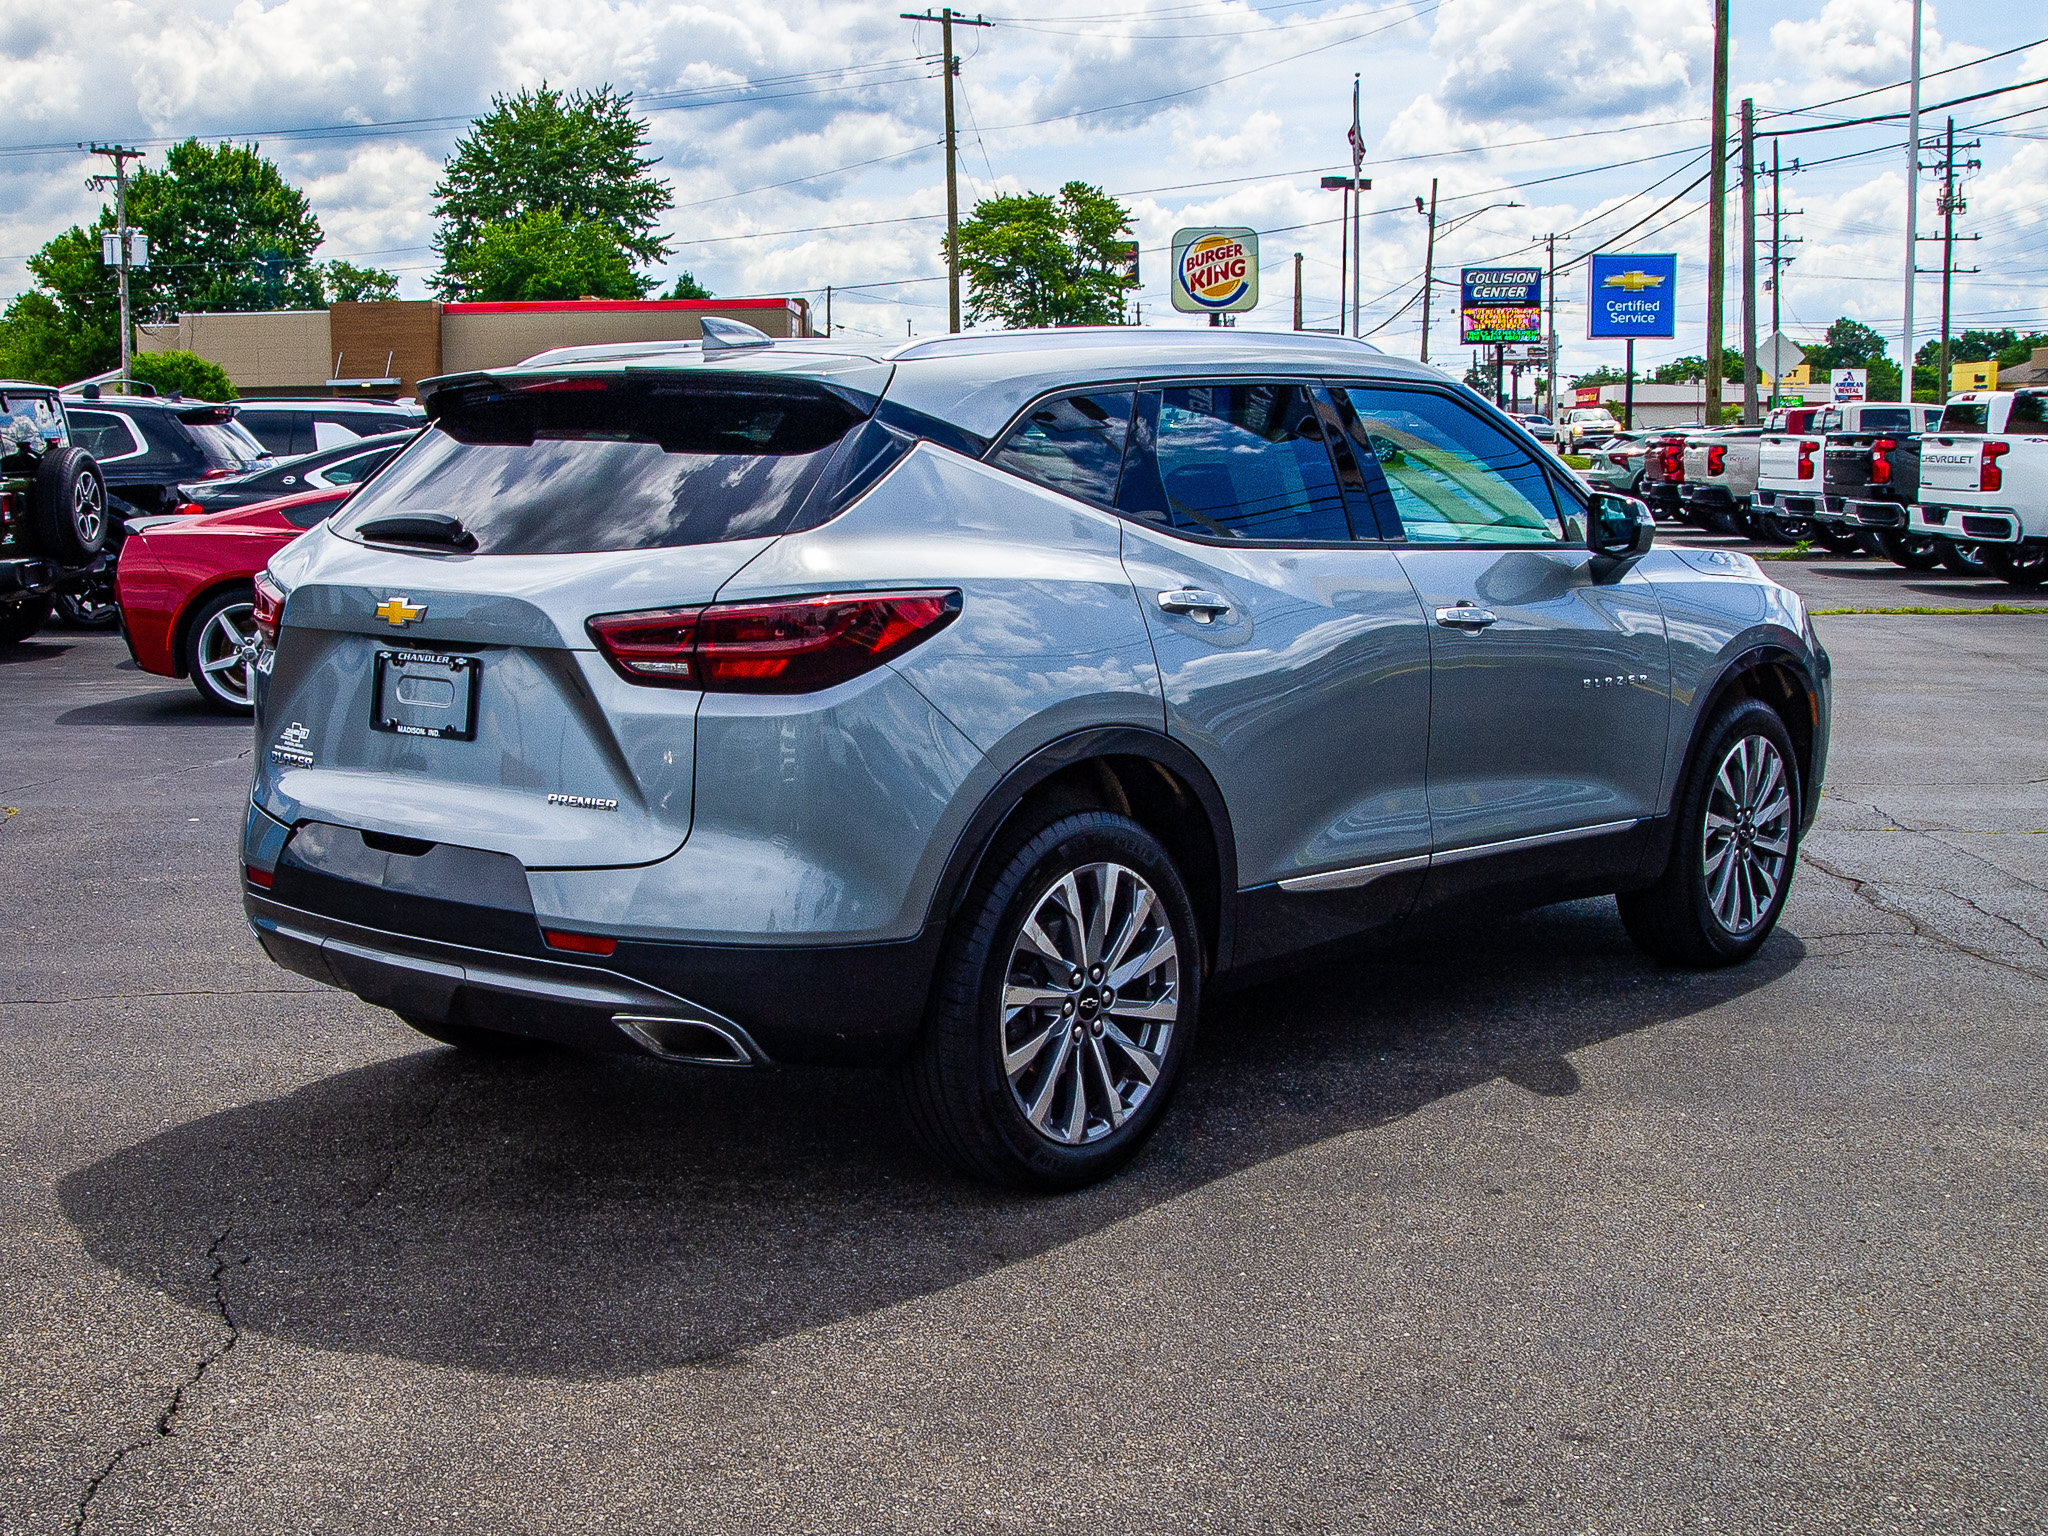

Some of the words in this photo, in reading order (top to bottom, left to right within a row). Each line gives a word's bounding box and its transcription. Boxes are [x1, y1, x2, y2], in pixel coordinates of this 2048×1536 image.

[1186, 243, 1243, 272] BURGER
[1190, 258, 1246, 293] KING
[1466, 271, 1538, 284] COLLISION
[1473, 285, 1527, 298] CENTER
[1606, 300, 1660, 311] Certified
[1610, 312, 1655, 323] Service
[1921, 454, 1974, 464] CHEVROLET
[397, 652, 450, 664] CHANDLER
[1582, 674, 1648, 689] BLAZER
[271, 750, 315, 770] BLAZER
[547, 793, 618, 812] PREMIER
